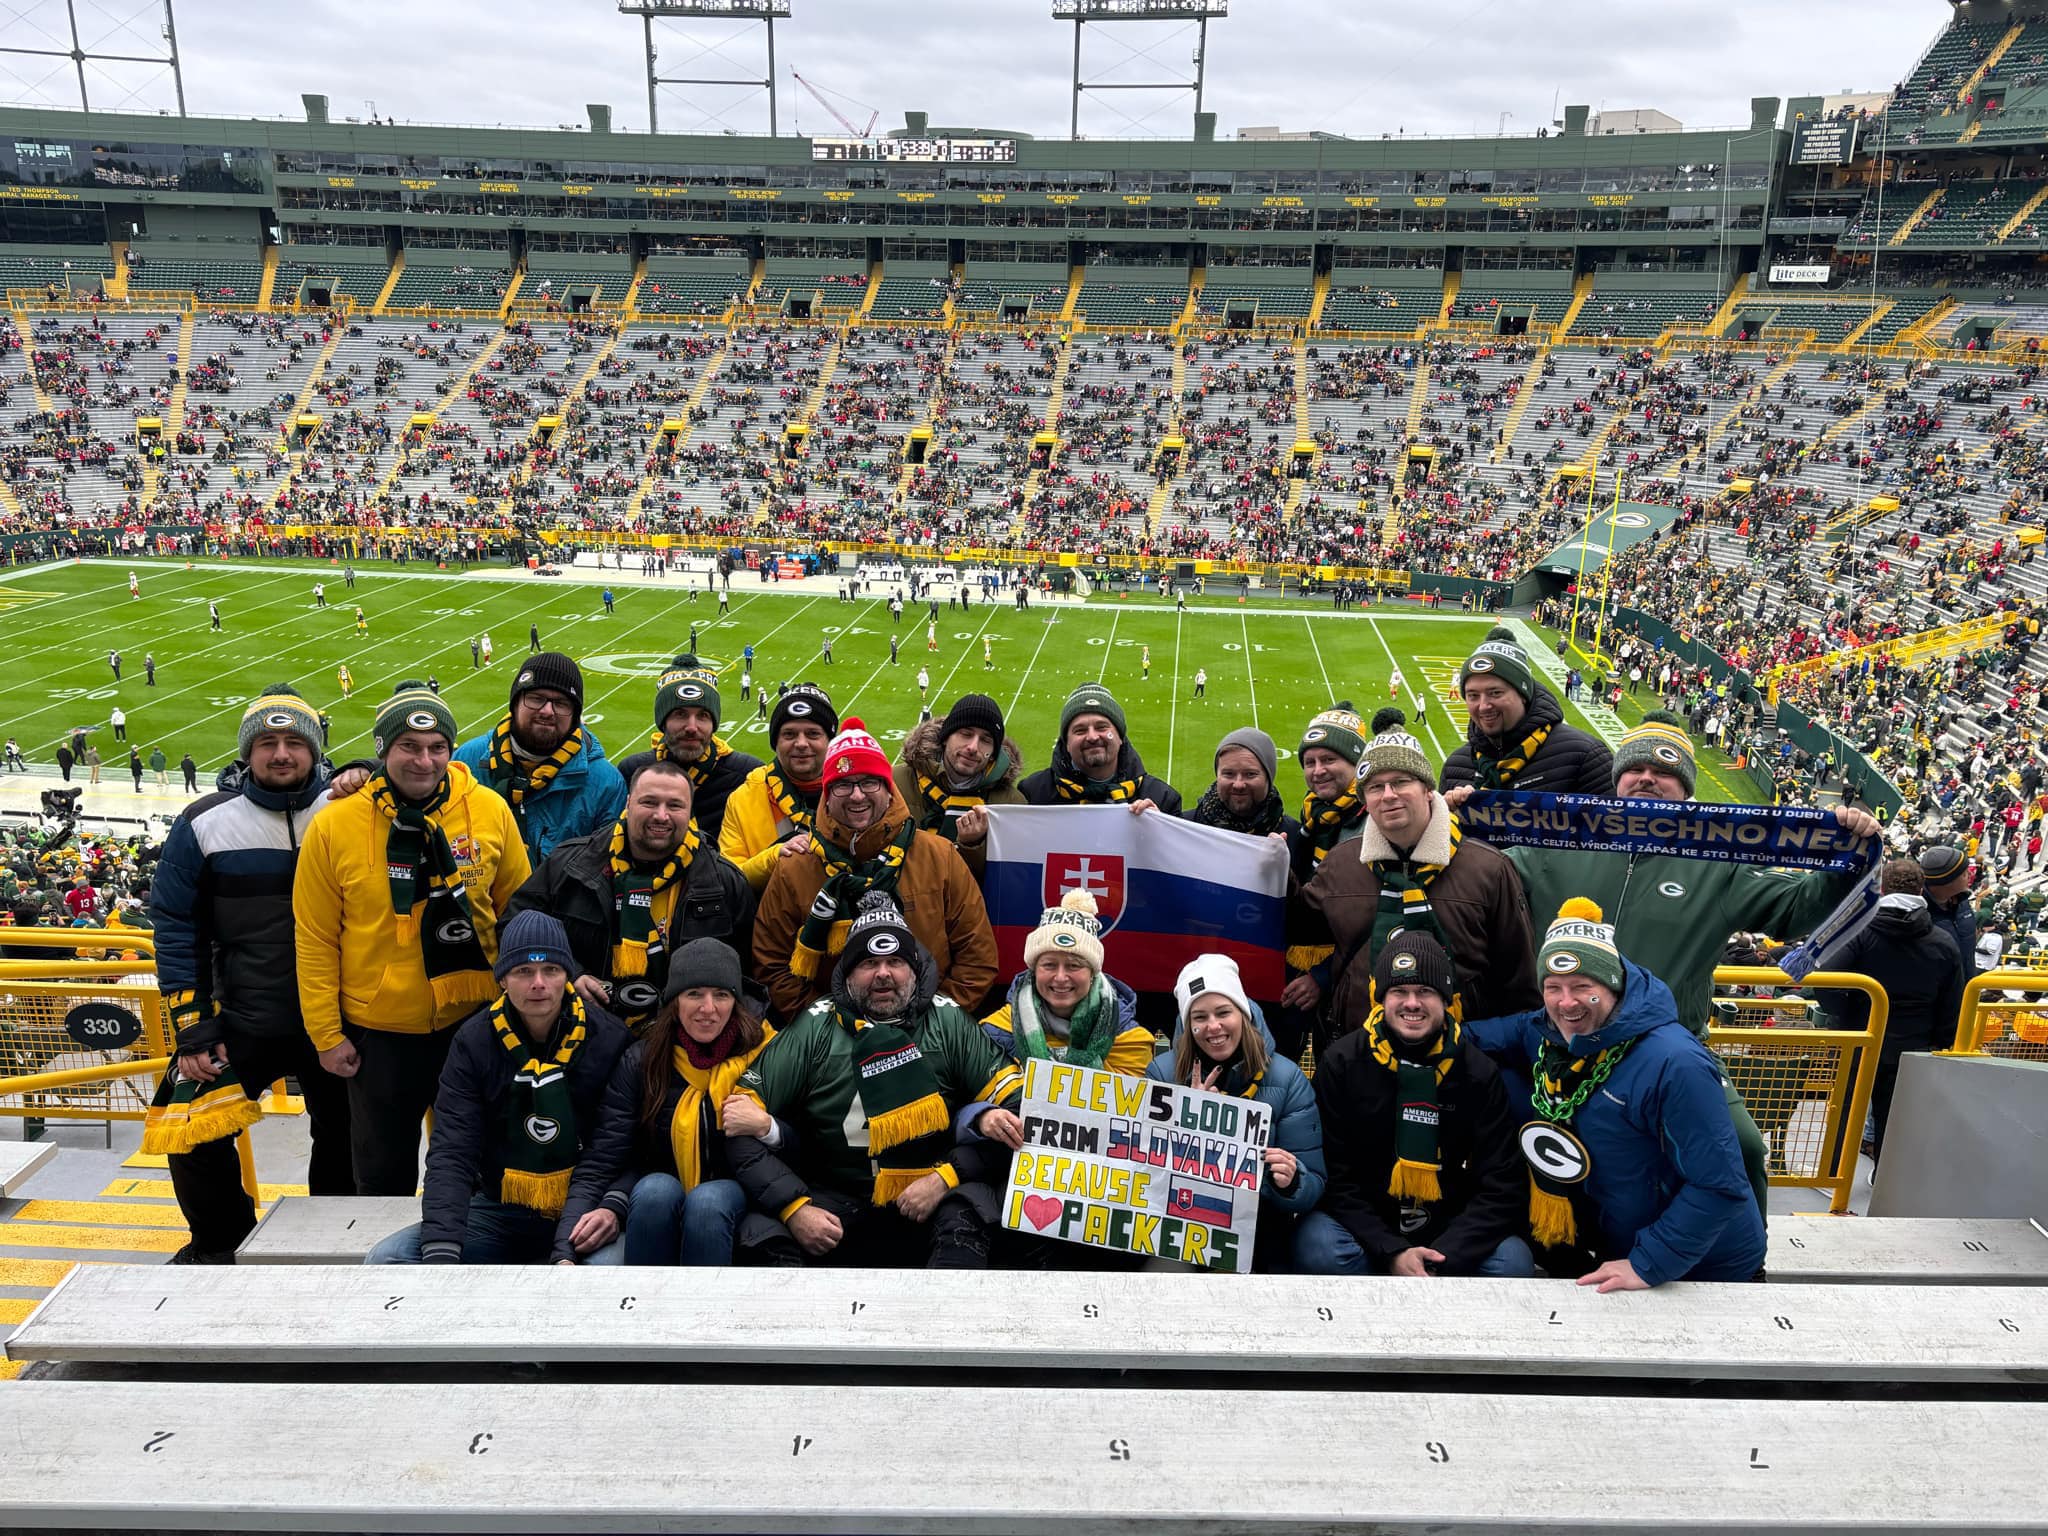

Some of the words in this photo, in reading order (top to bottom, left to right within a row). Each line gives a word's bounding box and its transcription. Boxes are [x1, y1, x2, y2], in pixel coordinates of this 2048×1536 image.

[901, 140, 930, 155] 53:39
[1375, 734, 1411, 747] BAY
[1555, 794, 1575, 804] VŠE
[1577, 795, 1624, 807] ZAČALO
[1653, 803, 1682, 811] 1922
[1699, 806, 1769, 816] HOSTINCI
[1785, 811, 1825, 820] DUBU
[1582, 808, 1767, 844] VŠECHNO
[1488, 833, 1524, 843] BANÍK
[1580, 840, 1633, 852] VÝROČNÍ
[1637, 843, 1678, 855] ZÁPAS
[1682, 848, 1698, 856] KE
[1702, 850, 1729, 859] STO
[1781, 856, 1826, 867] KLUBU,
[80, 898, 90, 908] 13
[83, 1018, 121, 1036] 330
[861, 1055, 897, 1073] AMERICAN
[1024, 1060, 1037, 1100] I
[1047, 1065, 1147, 1118] FLEW
[1149, 1085, 1239, 1135] 5.600
[1023, 1116, 1099, 1154] FROM
[1106, 1117, 1258, 1191] SLOVAKIA
[1013, 1151, 1151, 1208] BECAUSE
[1009, 1190, 1025, 1229] I
[1058, 1200, 1240, 1271] PACKERS
[384, 1296, 405, 1310] 2
[619, 1296, 637, 1310] 3
[851, 1301, 866, 1315] 4
[1083, 1304, 1099, 1319] 5
[143, 1431, 176, 1453] 2
[468, 1433, 493, 1455] 3
[792, 1434, 813, 1457] 4
[1107, 1438, 1130, 1460] 5
